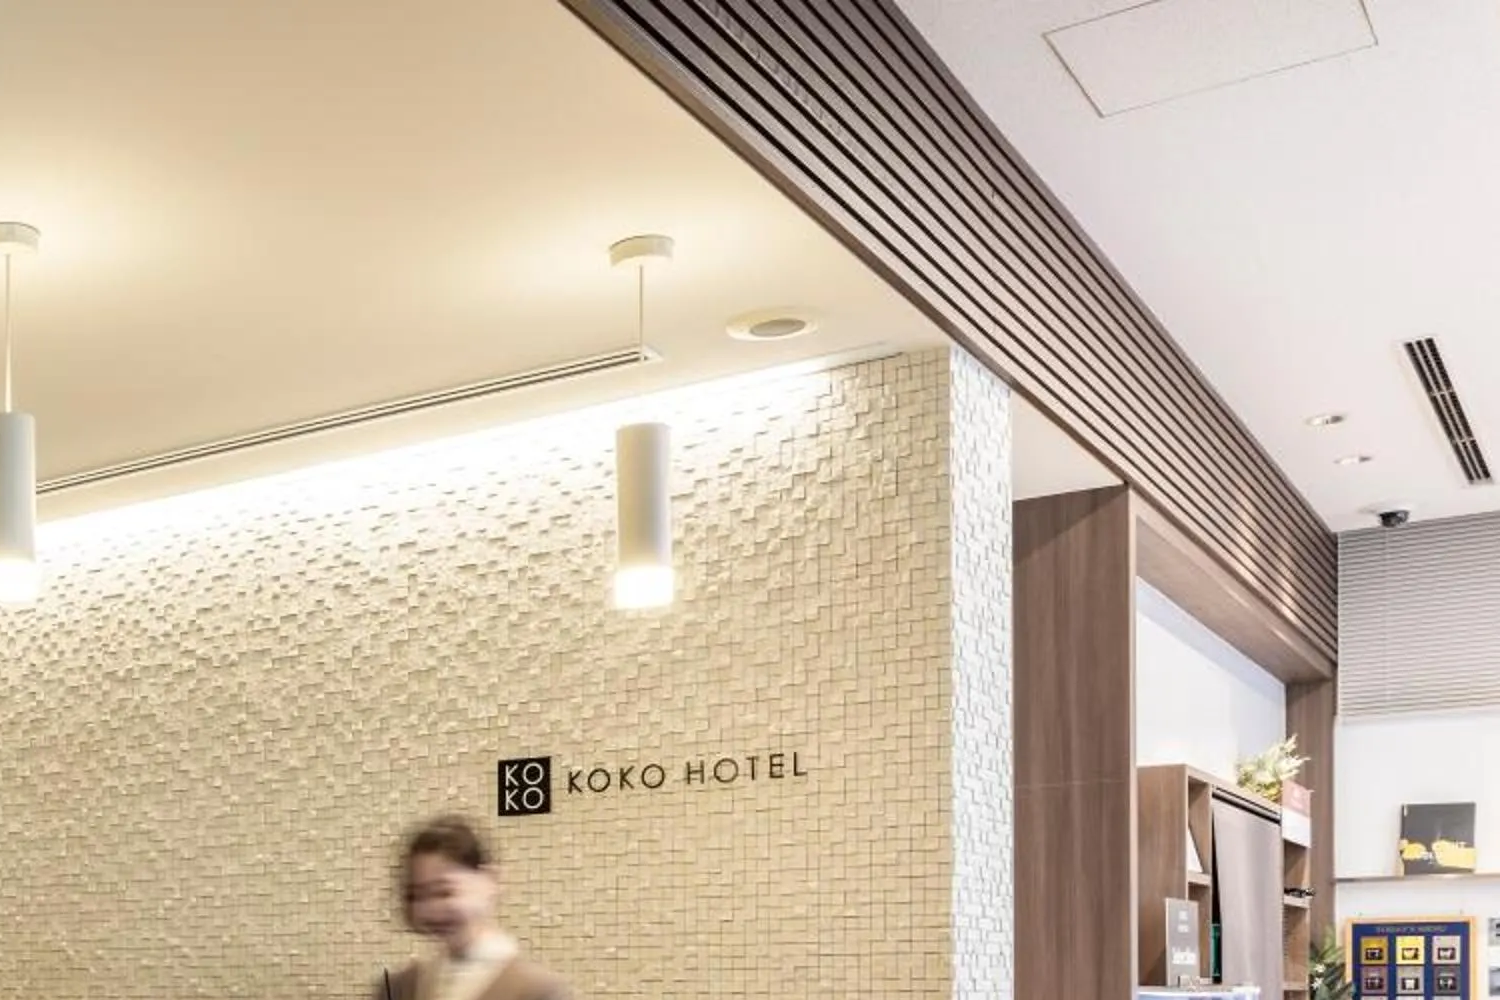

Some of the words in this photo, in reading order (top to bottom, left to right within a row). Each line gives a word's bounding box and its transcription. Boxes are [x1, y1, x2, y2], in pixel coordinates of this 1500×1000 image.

[504, 762, 545, 787] KO
[567, 764, 665, 794] KOKO
[686, 751, 808, 784] HOTEL
[504, 787, 545, 811] KO
